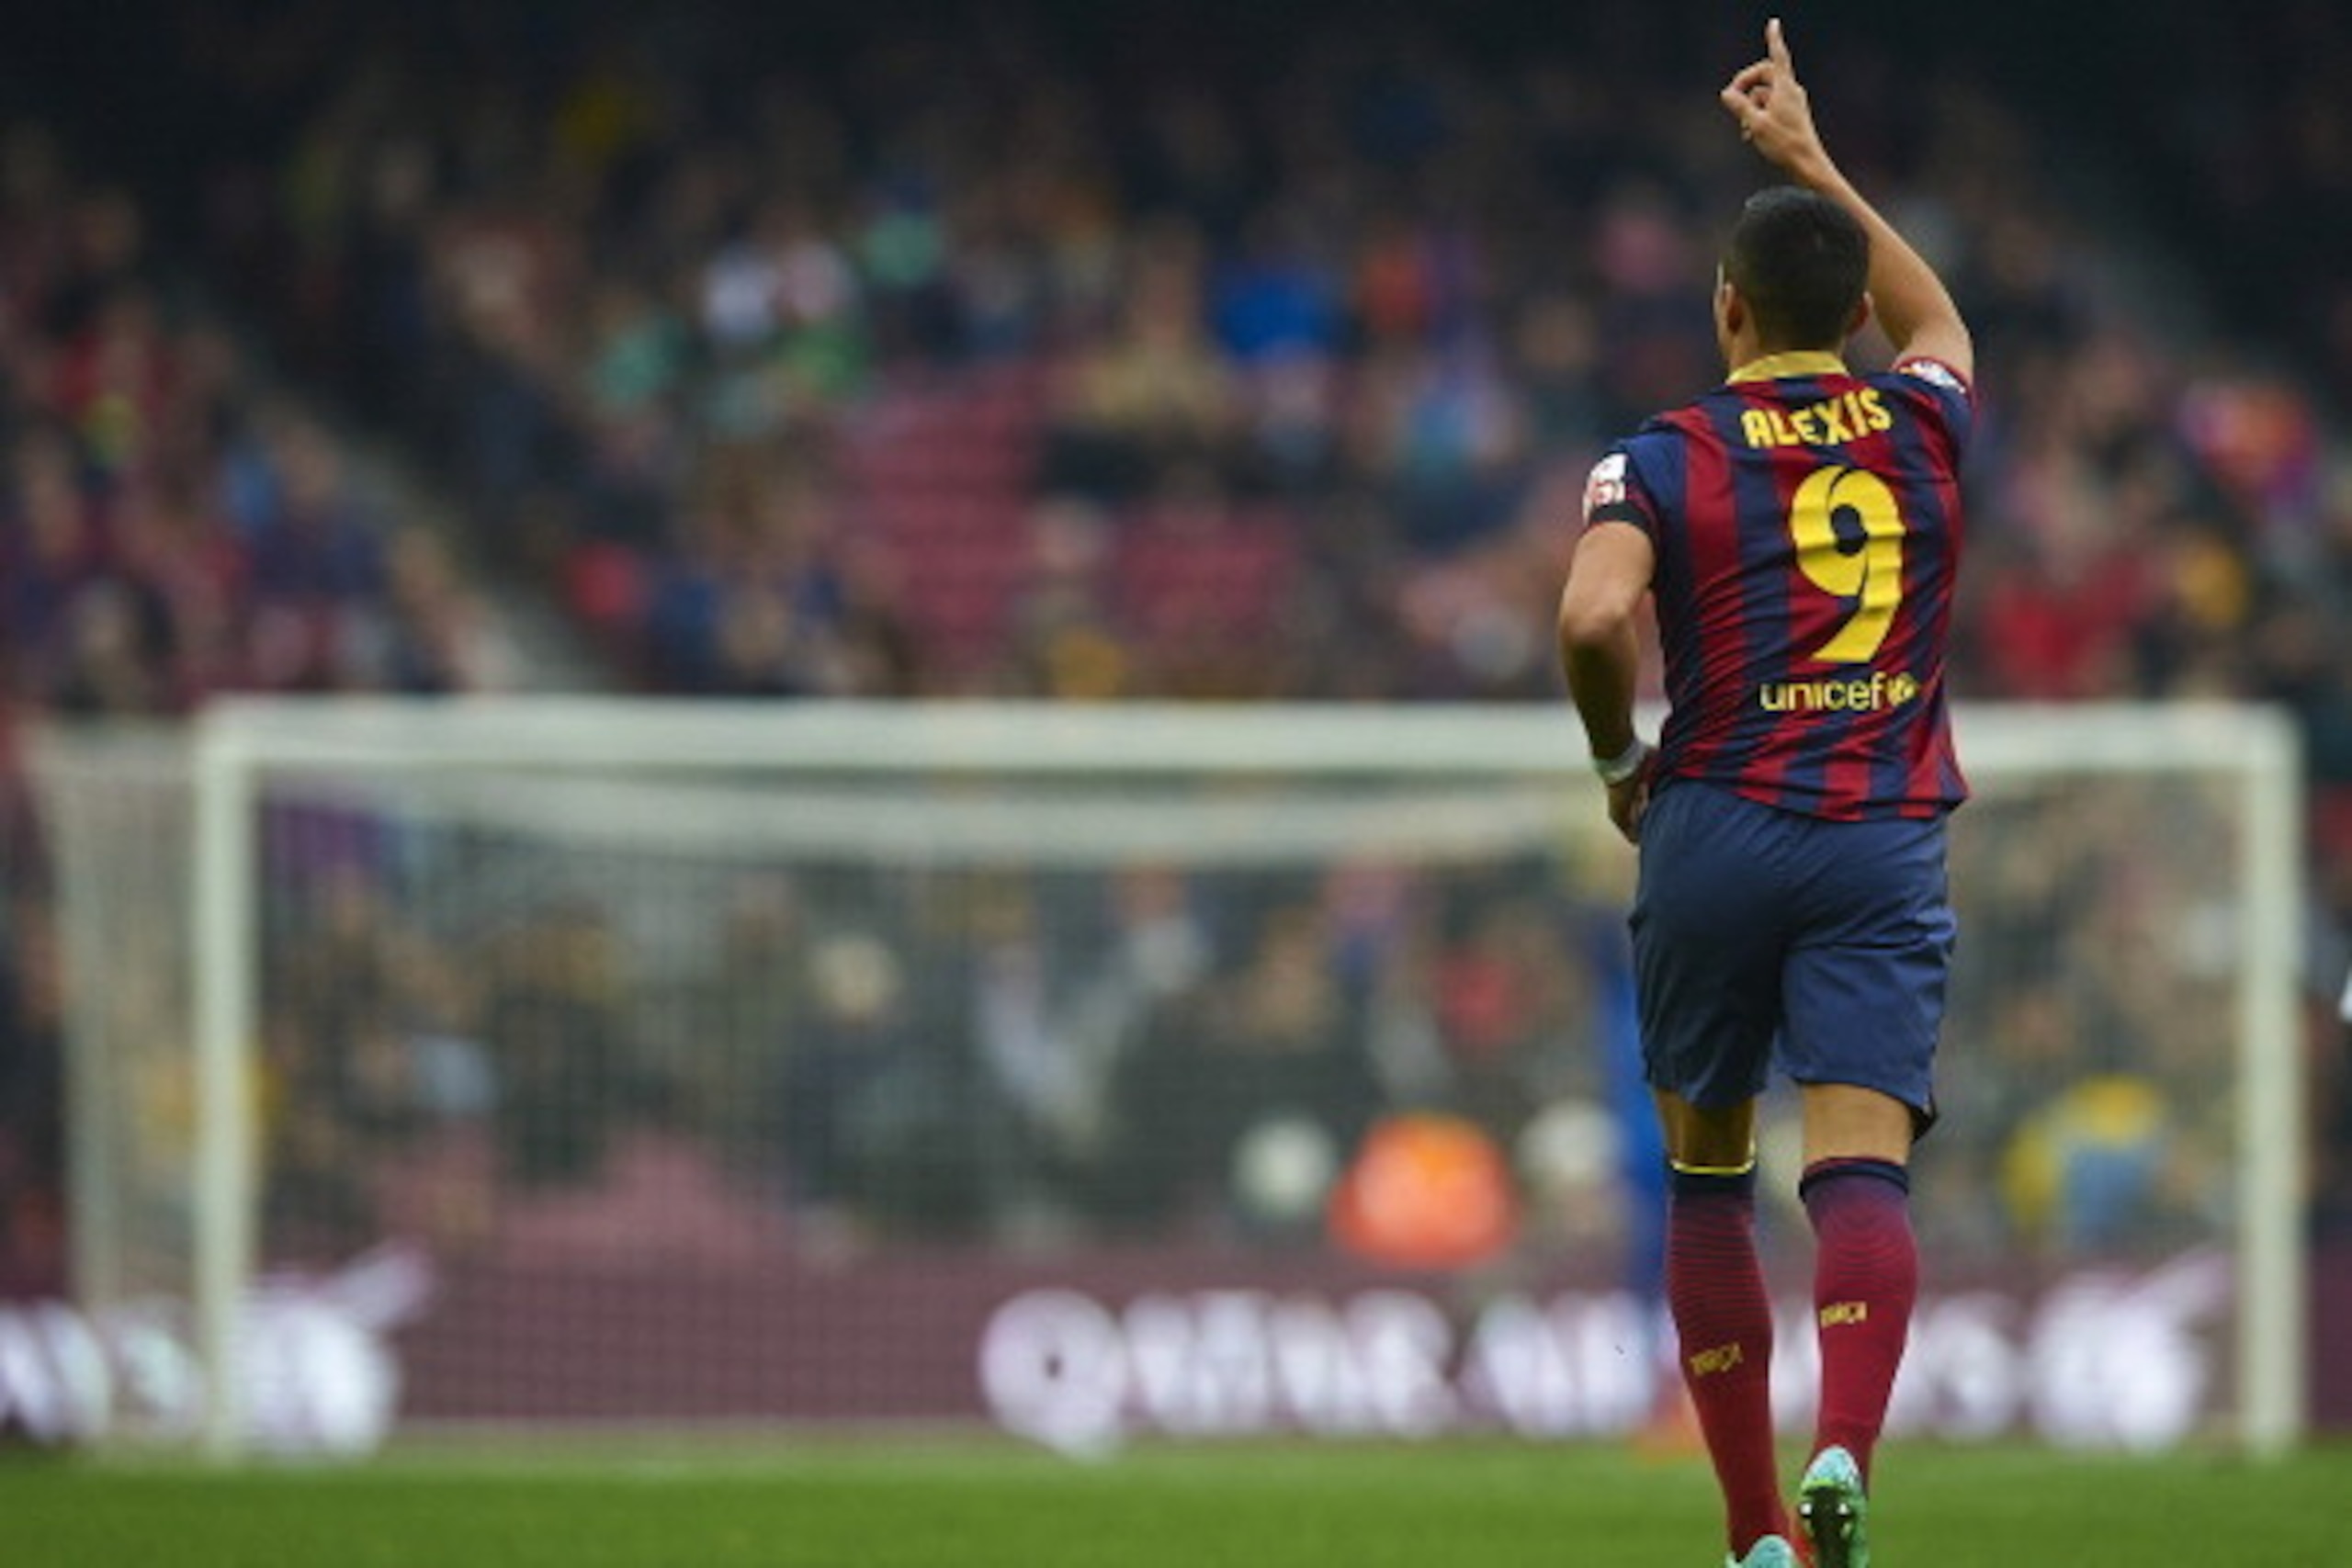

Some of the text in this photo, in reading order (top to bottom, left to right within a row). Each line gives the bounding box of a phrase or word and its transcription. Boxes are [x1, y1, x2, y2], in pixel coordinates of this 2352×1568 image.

[1741, 389, 1892, 447] ALEXIS
[1791, 467, 1905, 661] 9
[1758, 671, 1887, 711] unicef
